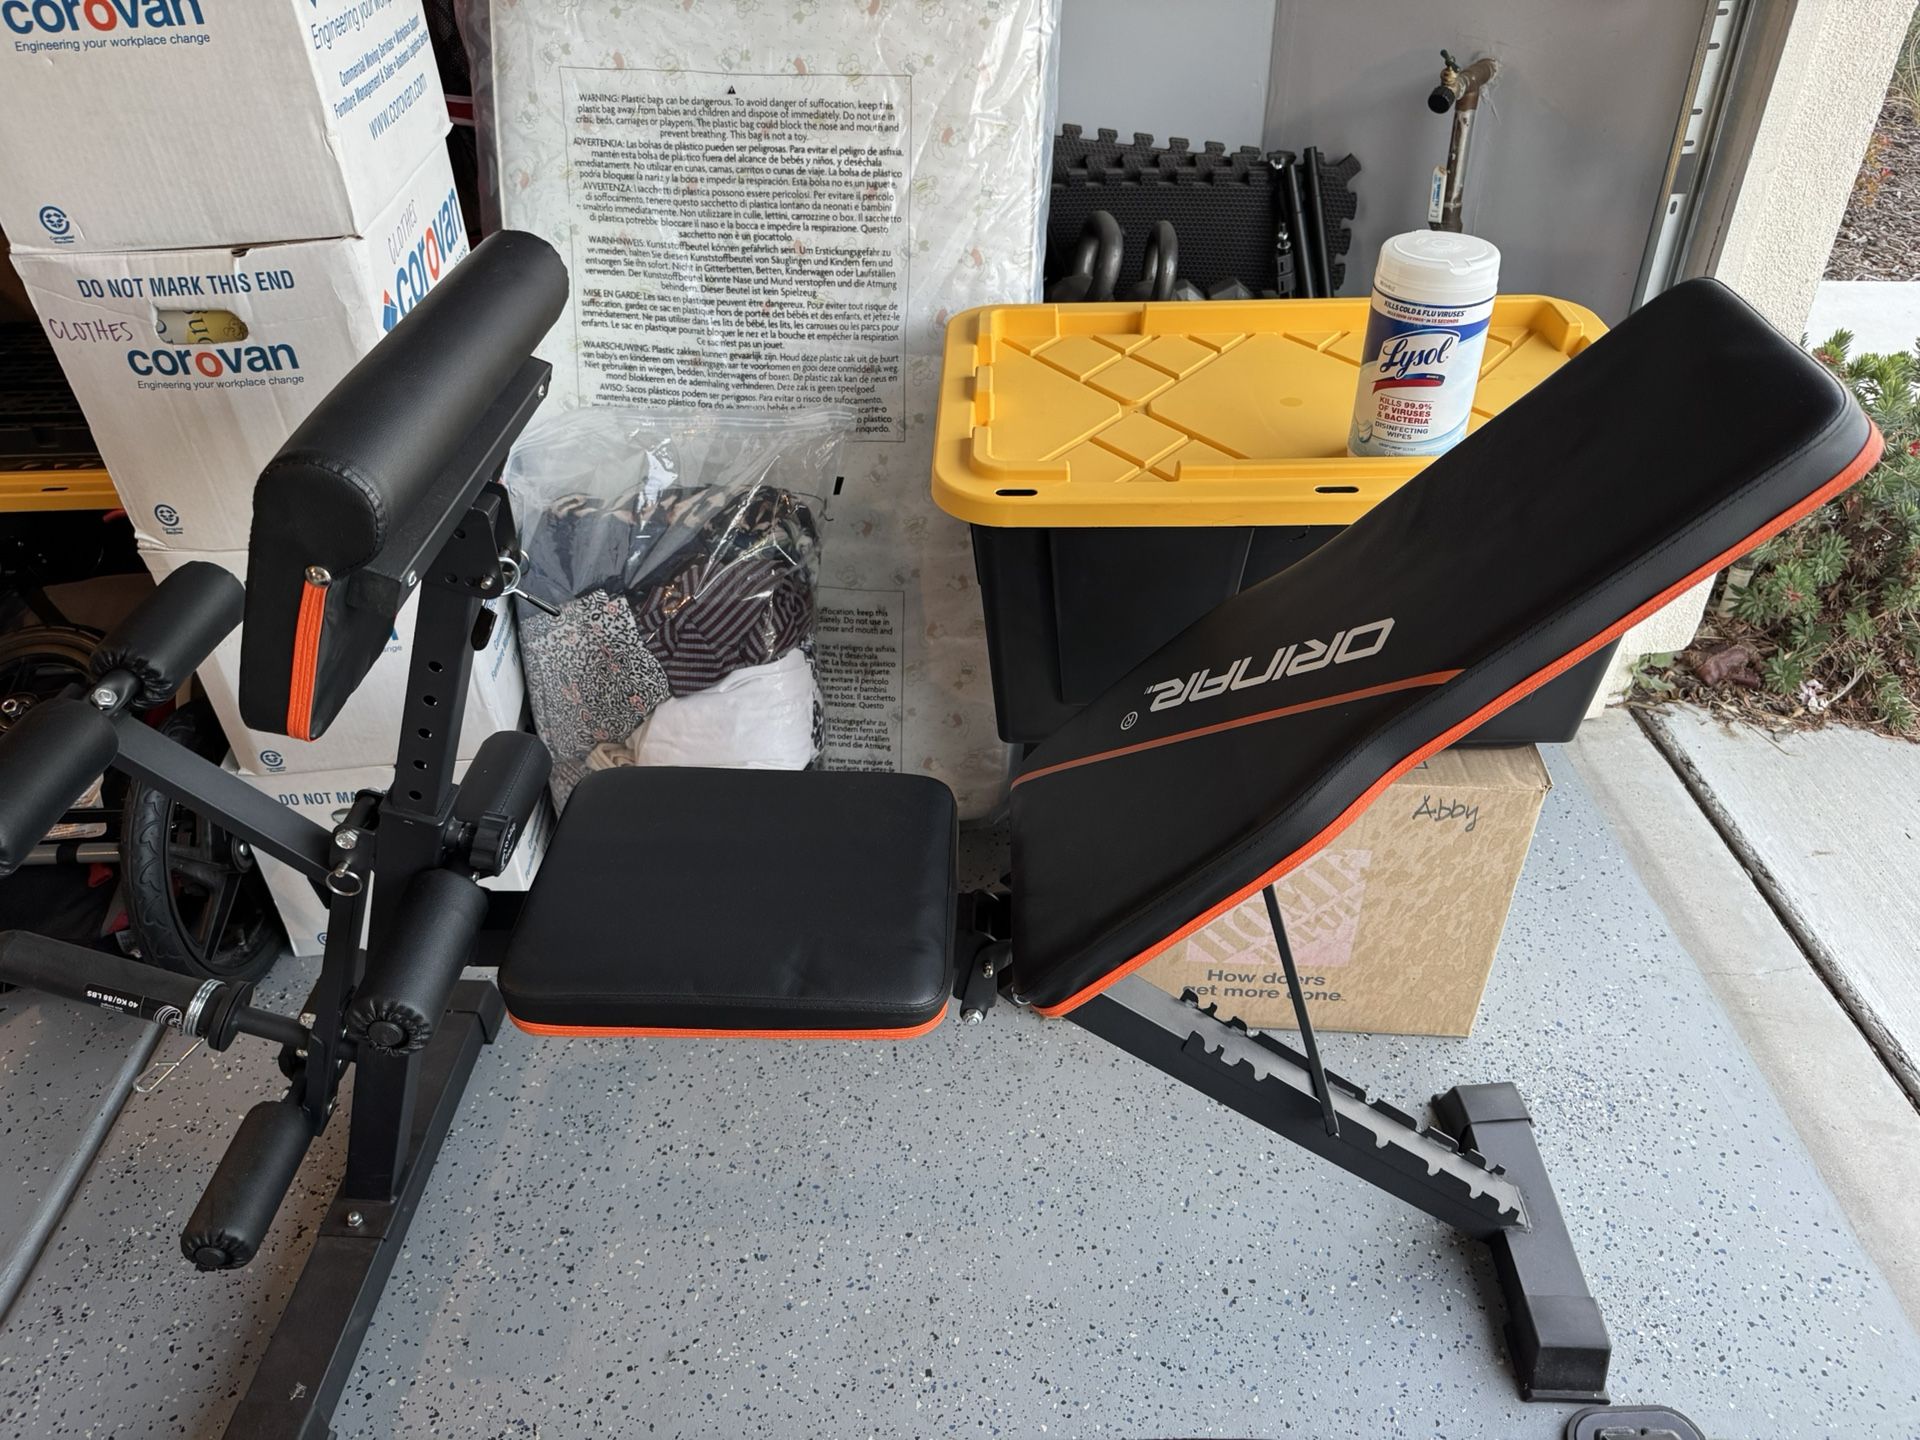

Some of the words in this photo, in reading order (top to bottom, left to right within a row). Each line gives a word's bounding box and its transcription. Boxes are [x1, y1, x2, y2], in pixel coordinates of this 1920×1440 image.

[2, 0, 205, 34] corovan
[311, 6, 360, 50] Engineering
[15, 40, 80, 53] Engineering
[83, 40, 107, 51] your
[110, 36, 167, 48] workplace
[170, 33, 211, 46] change
[368, 73, 428, 140] www.corovan.com
[621, 94, 645, 102] Plastic
[647, 95, 663, 105] bags
[680, 96, 689, 104] be
[734, 97, 743, 106] To
[746, 98, 767, 106] avoid
[769, 98, 796, 109] danger
[799, 99, 807, 107] of
[858, 100, 877, 111] keep
[601, 105, 615, 116] bag
[617, 108, 635, 116] away
[682, 107, 696, 115] and
[698, 107, 729, 116] children
[731, 108, 745, 116] and
[748, 109, 778, 120] dispose
[780, 109, 788, 118] of
[842, 111, 854, 119] Do
[856, 112, 870, 120] not
[696, 118, 710, 127] The
[712, 119, 737, 130] plastic
[740, 119, 754, 130] bag
[780, 120, 802, 129] block
[804, 121, 817, 129] the
[840, 122, 854, 130] and
[883, 123, 899, 131] and
[660, 130, 688, 139] prevent
[729, 130, 746, 138] This
[748, 130, 762, 141] bag
[763, 131, 769, 139] is
[771, 132, 785, 140] not
[396, 188, 462, 318] corovan
[76, 279, 104, 298] DO
[108, 278, 144, 298] NOT
[150, 276, 204, 297] MARK
[206, 272, 252, 295] THIS
[255, 270, 294, 291] END
[726, 285, 750, 294] Beutel
[751, 286, 760, 294] ist
[1384, 300, 1399, 310] KILLS
[1400, 306, 1416, 314] COLD
[1437, 310, 1465, 318] VIRUSES
[48, 318, 133, 343] CLOTHES
[738, 341, 750, 350] pas
[127, 343, 300, 378] corovan
[1380, 336, 1454, 380] Lysol
[138, 380, 191, 392] Engineering
[193, 381, 216, 390] your
[217, 377, 266, 388] workplace
[268, 374, 304, 386] change
[625, 384, 646, 393] Sacos
[682, 389, 707, 400] podem
[822, 395, 831, 403] de
[1380, 396, 1402, 407] KILLS
[1404, 402, 1432, 410] 99.9%
[1384, 413, 1429, 424] BACTERIA
[1392, 407, 1430, 417] VIRUSES
[1375, 420, 1428, 434] DISINFECTING
[1387, 430, 1412, 440] WIPES
[1148, 617, 1395, 712] ORINAR
[278, 794, 300, 806] DO
[303, 792, 331, 805] NOT
[1412, 794, 1479, 832] Abby
[1207, 969, 1256, 983] How
[86, 990, 102, 1000] LBS
[1224, 986, 1280, 998] more
[103, 994, 128, 1006] KG/88
[128, 1000, 139, 1008] 40
